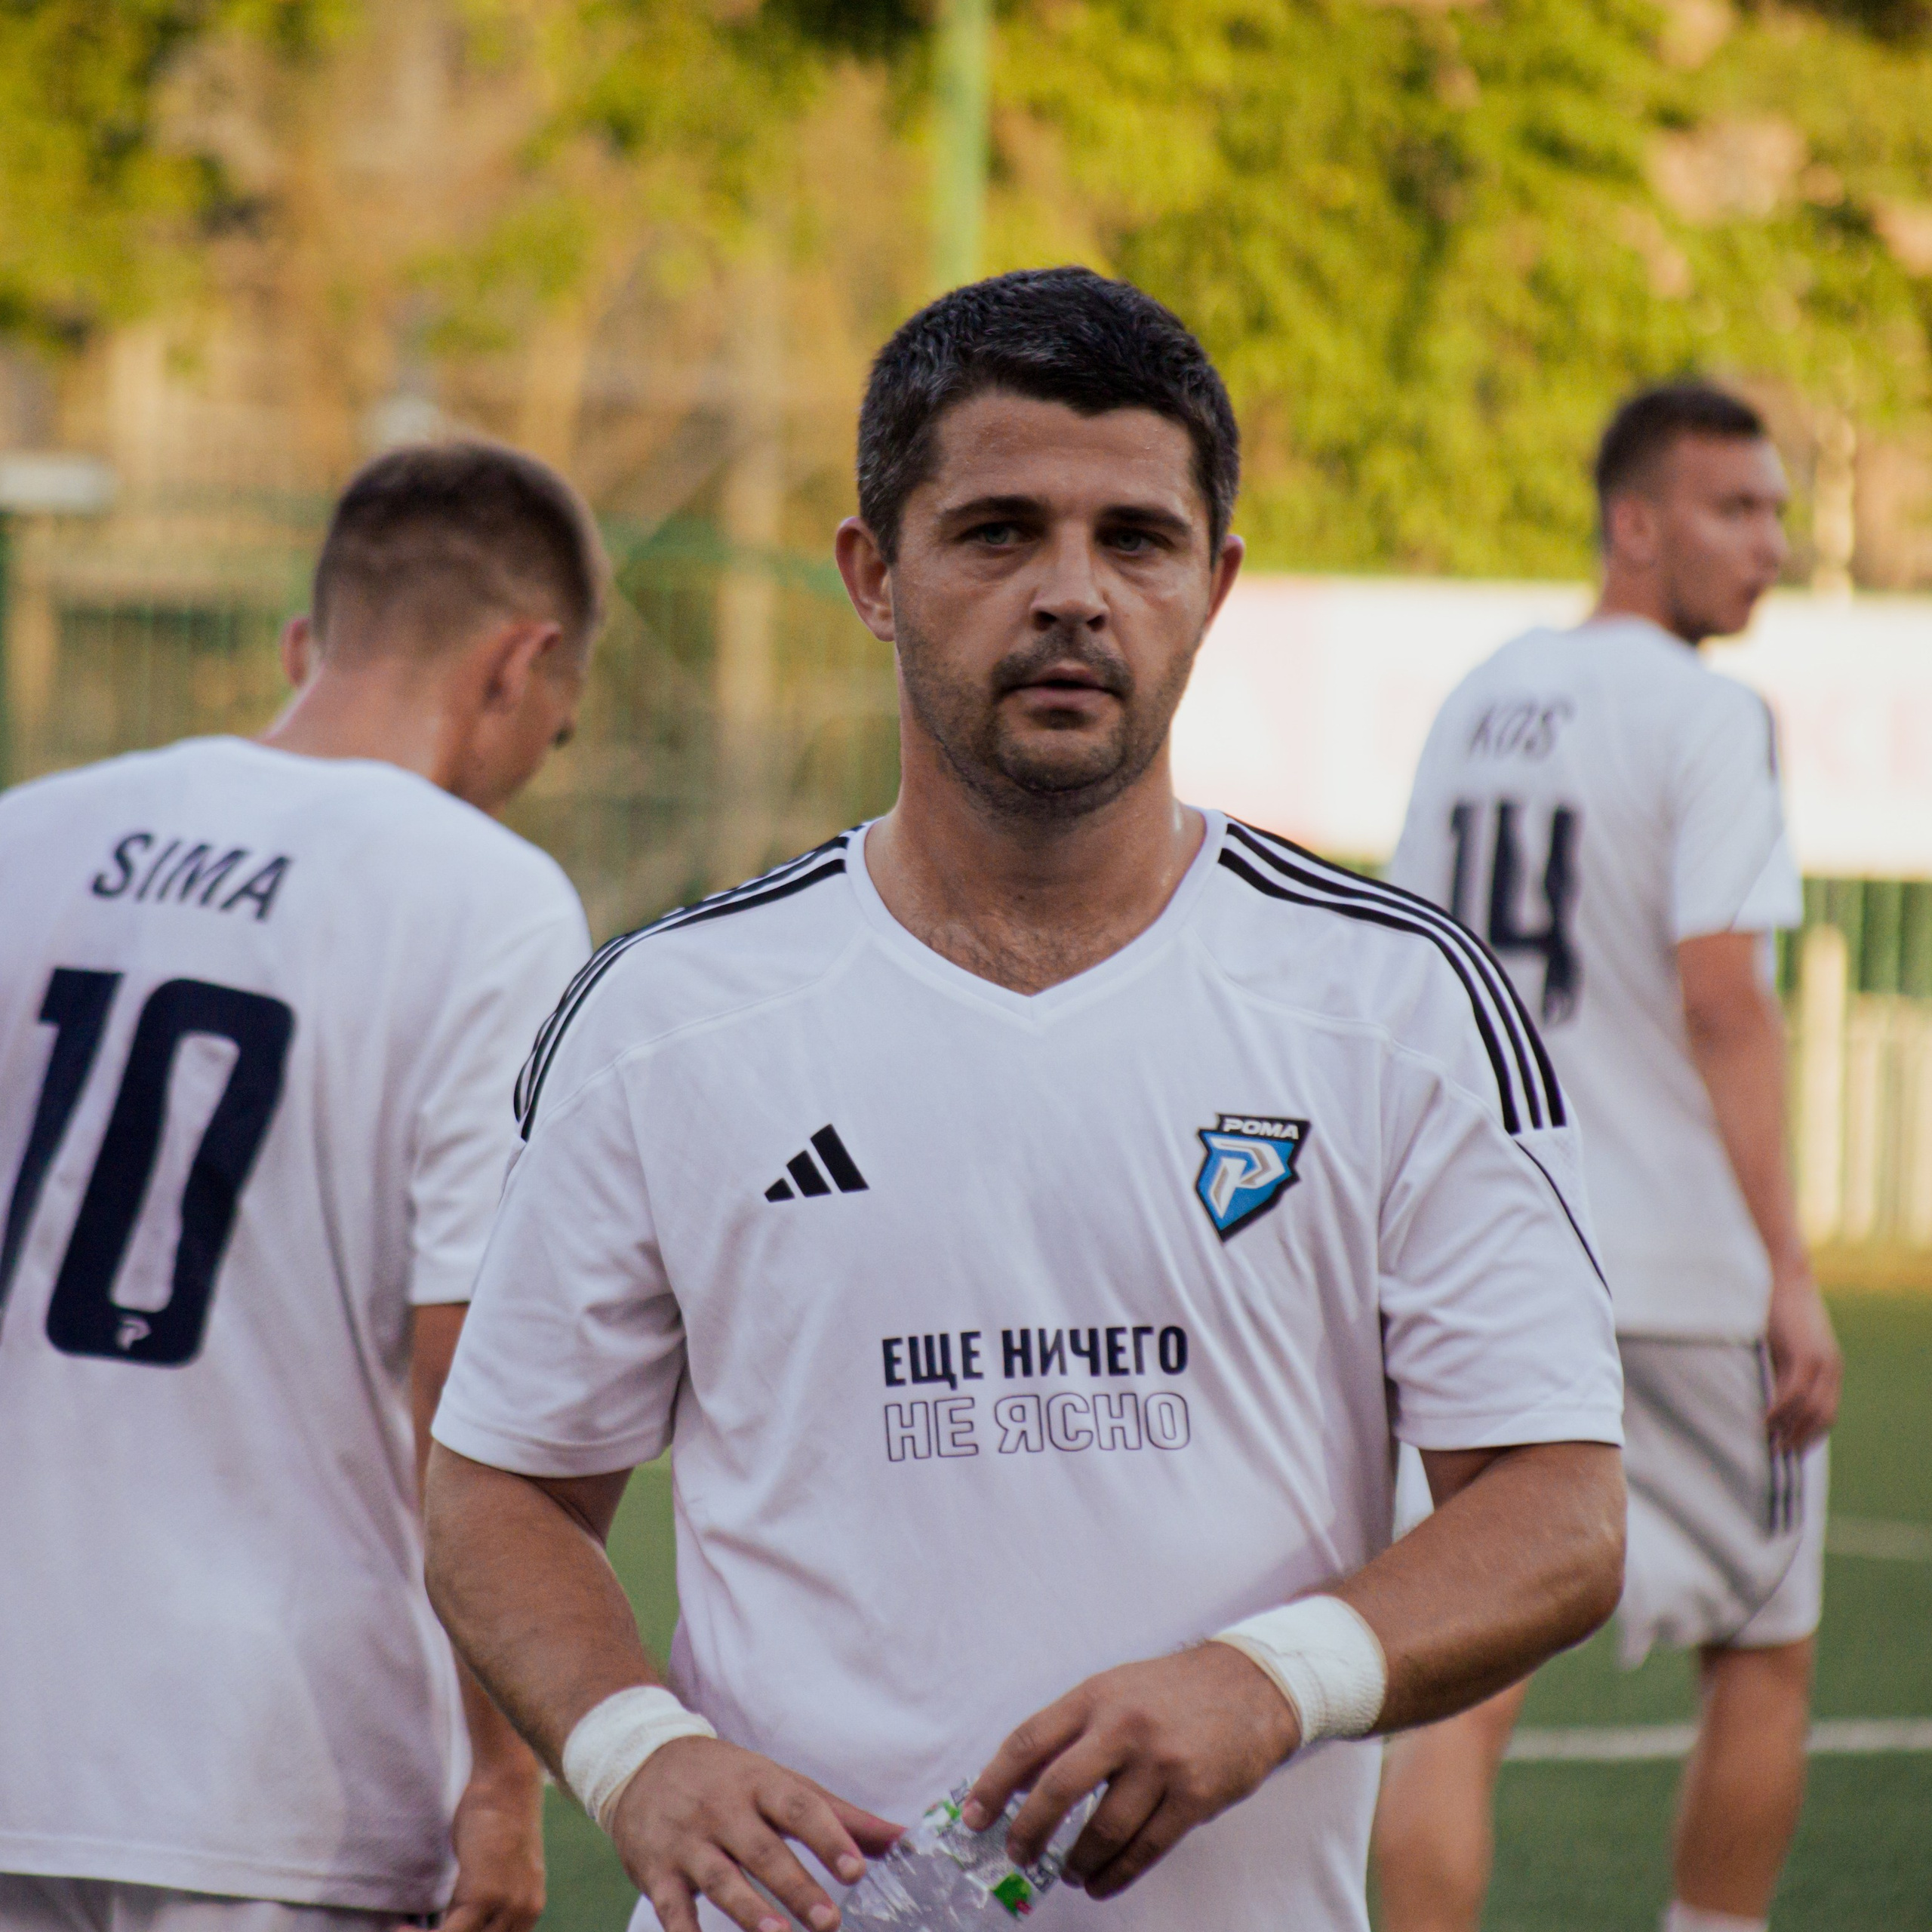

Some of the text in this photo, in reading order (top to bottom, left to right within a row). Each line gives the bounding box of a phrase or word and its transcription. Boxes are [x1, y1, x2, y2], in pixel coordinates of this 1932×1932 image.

[91, 832, 294, 924] SIMA
[0, 968, 297, 1369] 10
[882, 1326, 1189, 1390] ЕЩЕ НИЧЕГО
[884, 1392, 1191, 1462] НЕ ЯСНО
